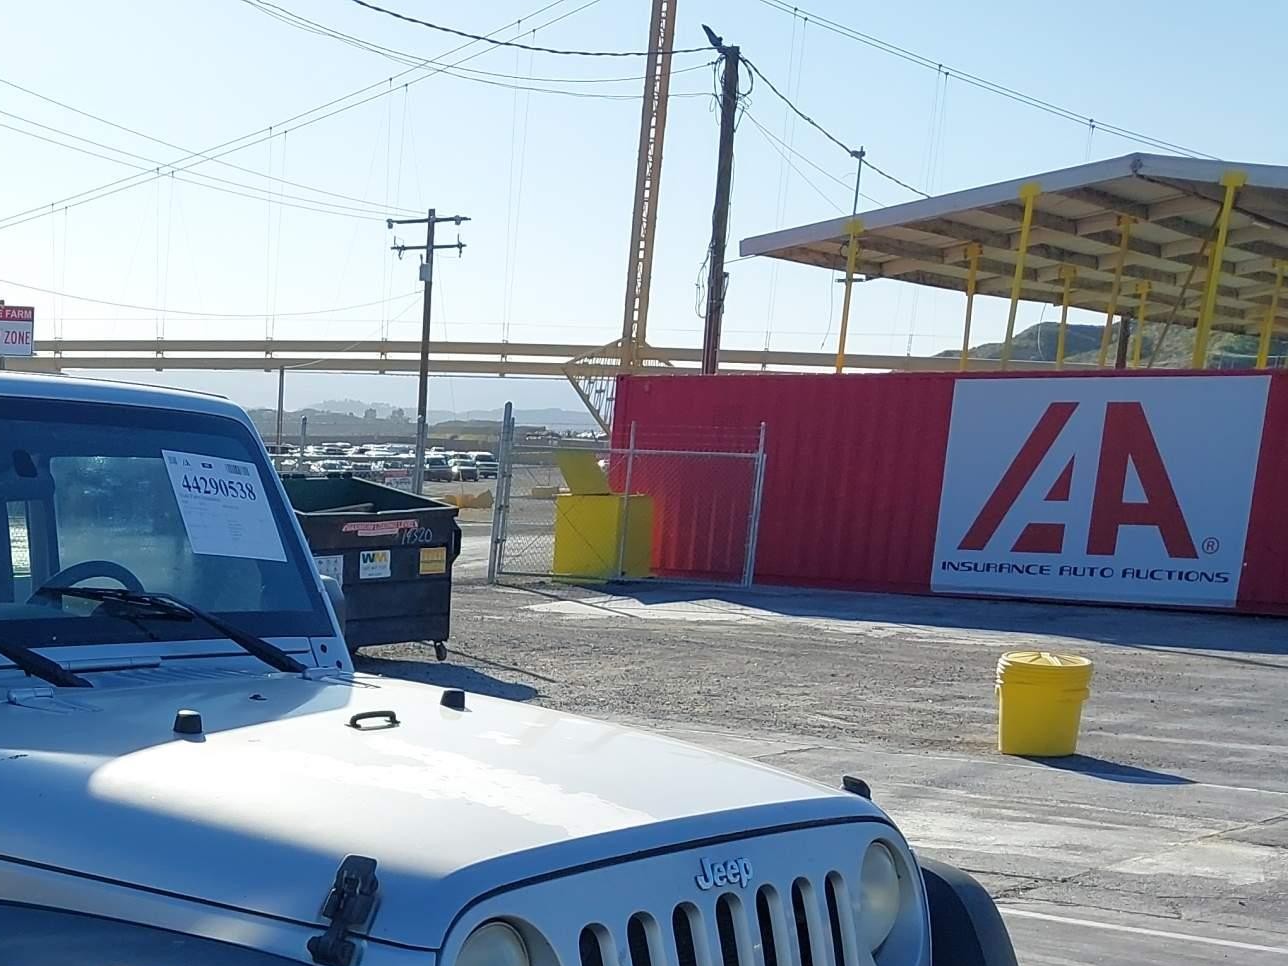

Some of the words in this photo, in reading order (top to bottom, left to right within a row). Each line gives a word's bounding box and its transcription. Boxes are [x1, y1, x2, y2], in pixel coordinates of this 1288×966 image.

[5, 308, 32, 319] FARM
[4, 331, 31, 345] ZONE
[182, 474, 256, 501] 44290538
[362, 552, 388, 564] WM
[941, 560, 1051, 576] INSURANCE
[1059, 565, 1114, 579] AUTO
[1121, 567, 1229, 584] AUCTIONS
[695, 856, 753, 891] Jeep
